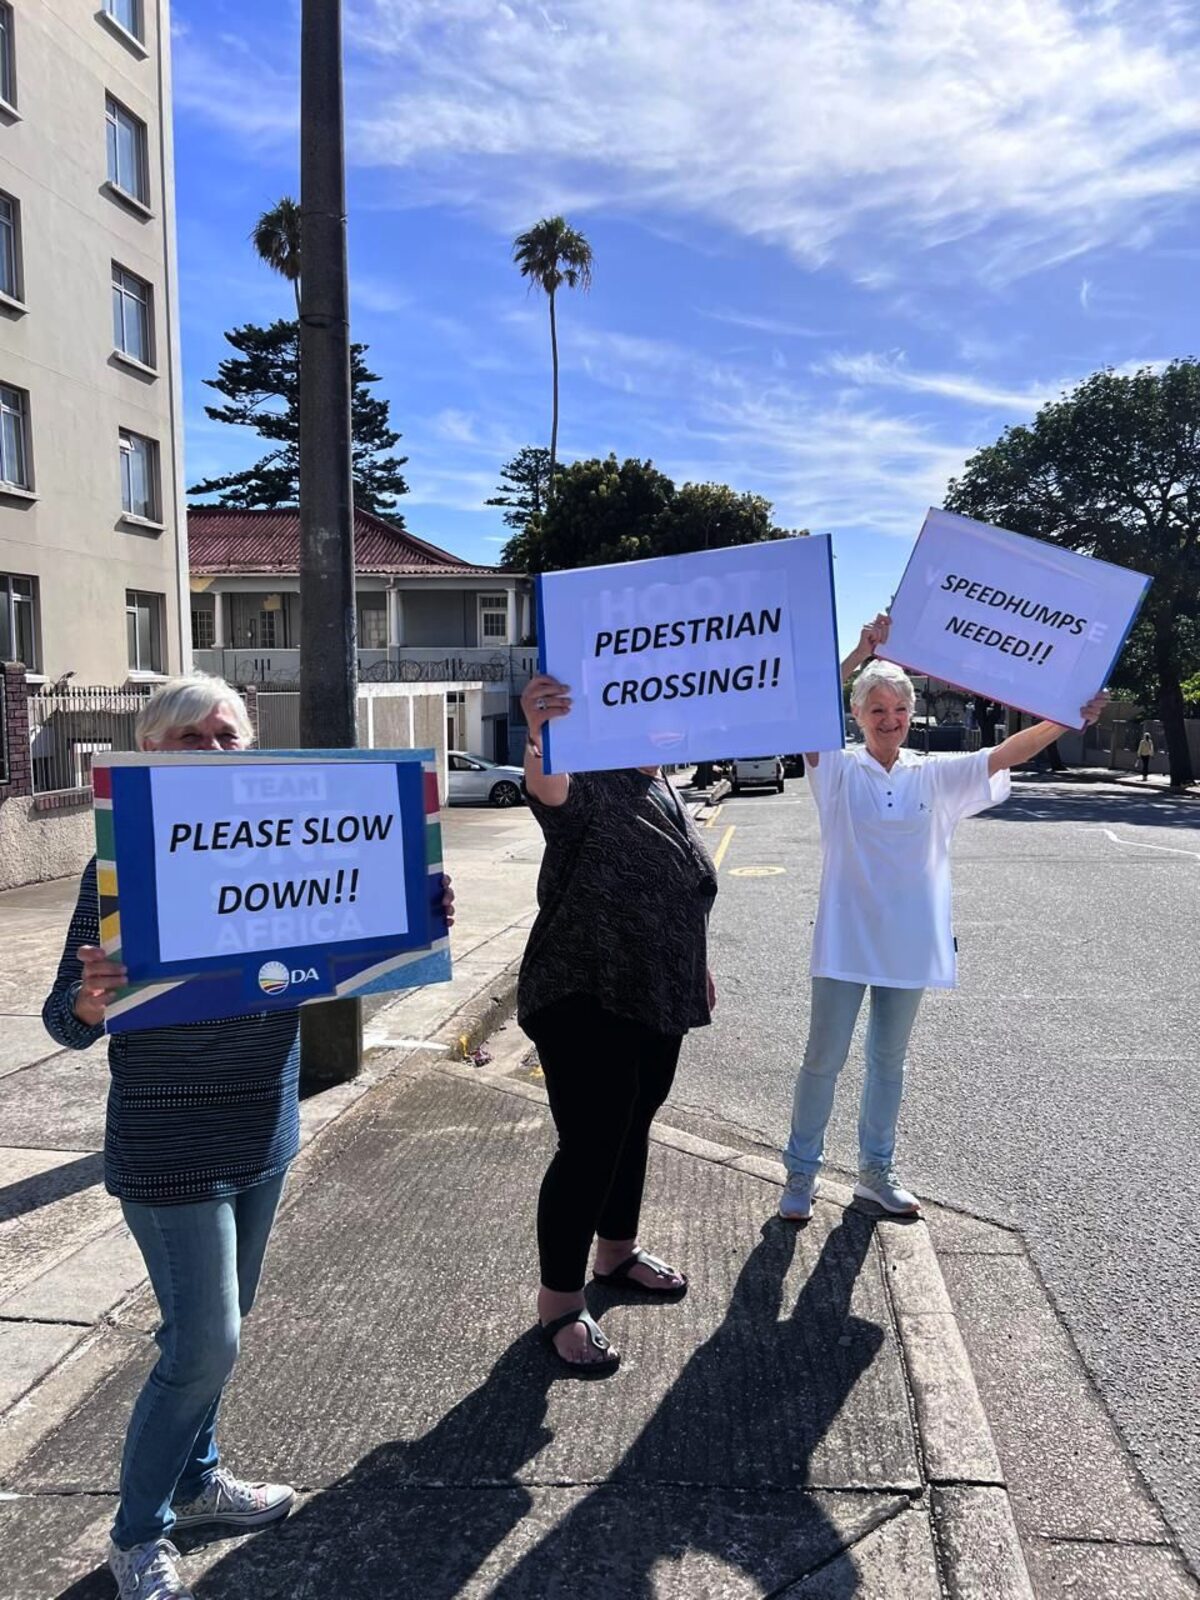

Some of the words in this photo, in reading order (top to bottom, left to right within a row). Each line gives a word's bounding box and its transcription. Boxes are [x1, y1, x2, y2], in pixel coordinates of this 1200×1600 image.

[940, 574, 1088, 635] SPEEDHUMPS
[594, 607, 782, 657] PEDESTRIAN
[944, 616, 1054, 666] NEEDED!!
[601, 657, 781, 706] CROSSING!!
[169, 819, 293, 852] PLEASE
[301, 814, 394, 844] SLOW
[217, 868, 360, 915] DOWN!!
[215, 909, 365, 951] AFRICA
[290, 968, 319, 984] DA
